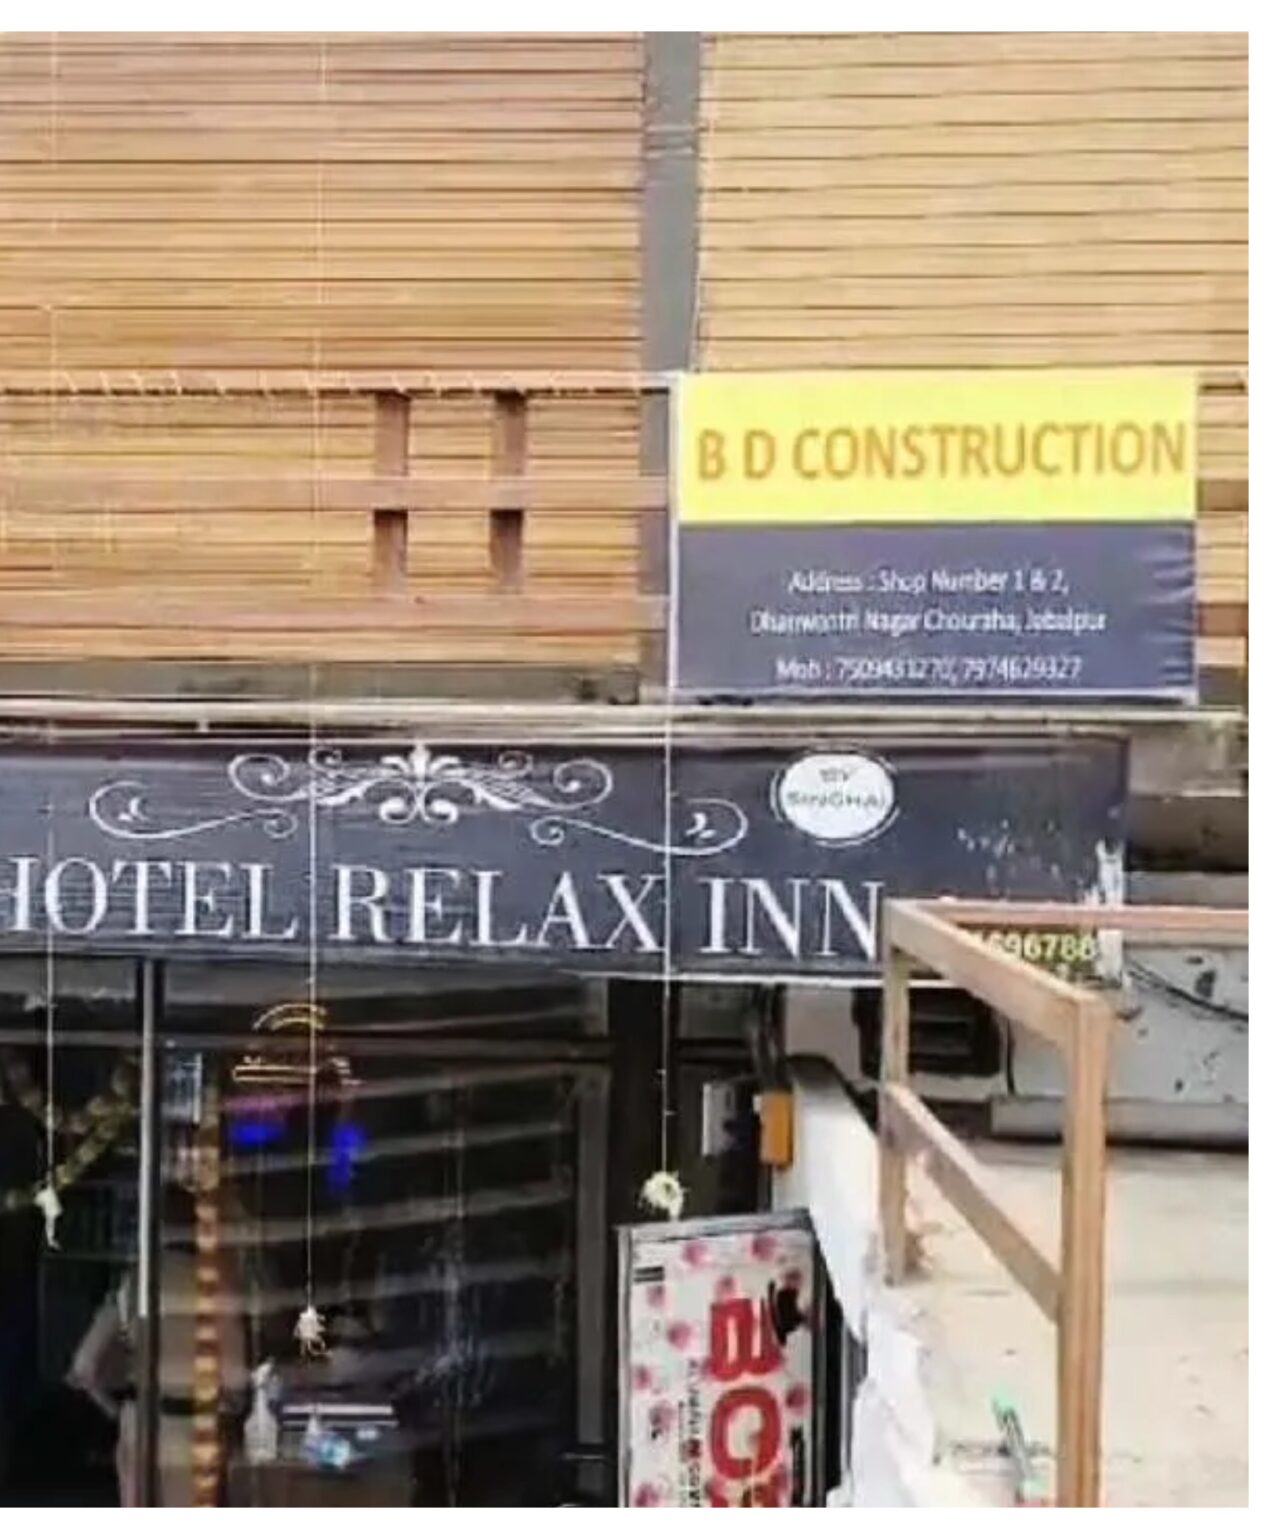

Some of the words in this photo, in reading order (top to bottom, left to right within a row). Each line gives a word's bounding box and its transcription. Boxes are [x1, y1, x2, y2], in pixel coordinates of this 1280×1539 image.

[698, 428, 725, 480] B
[744, 429, 777, 479] D
[792, 422, 1186, 478] CONSTRUCTION
[788, 569, 862, 593] Address
[877, 570, 926, 596] Shop
[932, 569, 1008, 592] Number
[1015, 570, 1025, 592] 1
[1030, 569, 1048, 592] &
[866, 609, 920, 637] Nagar
[329, 864, 667, 954] RELAX
[698, 876, 885, 962] INN
